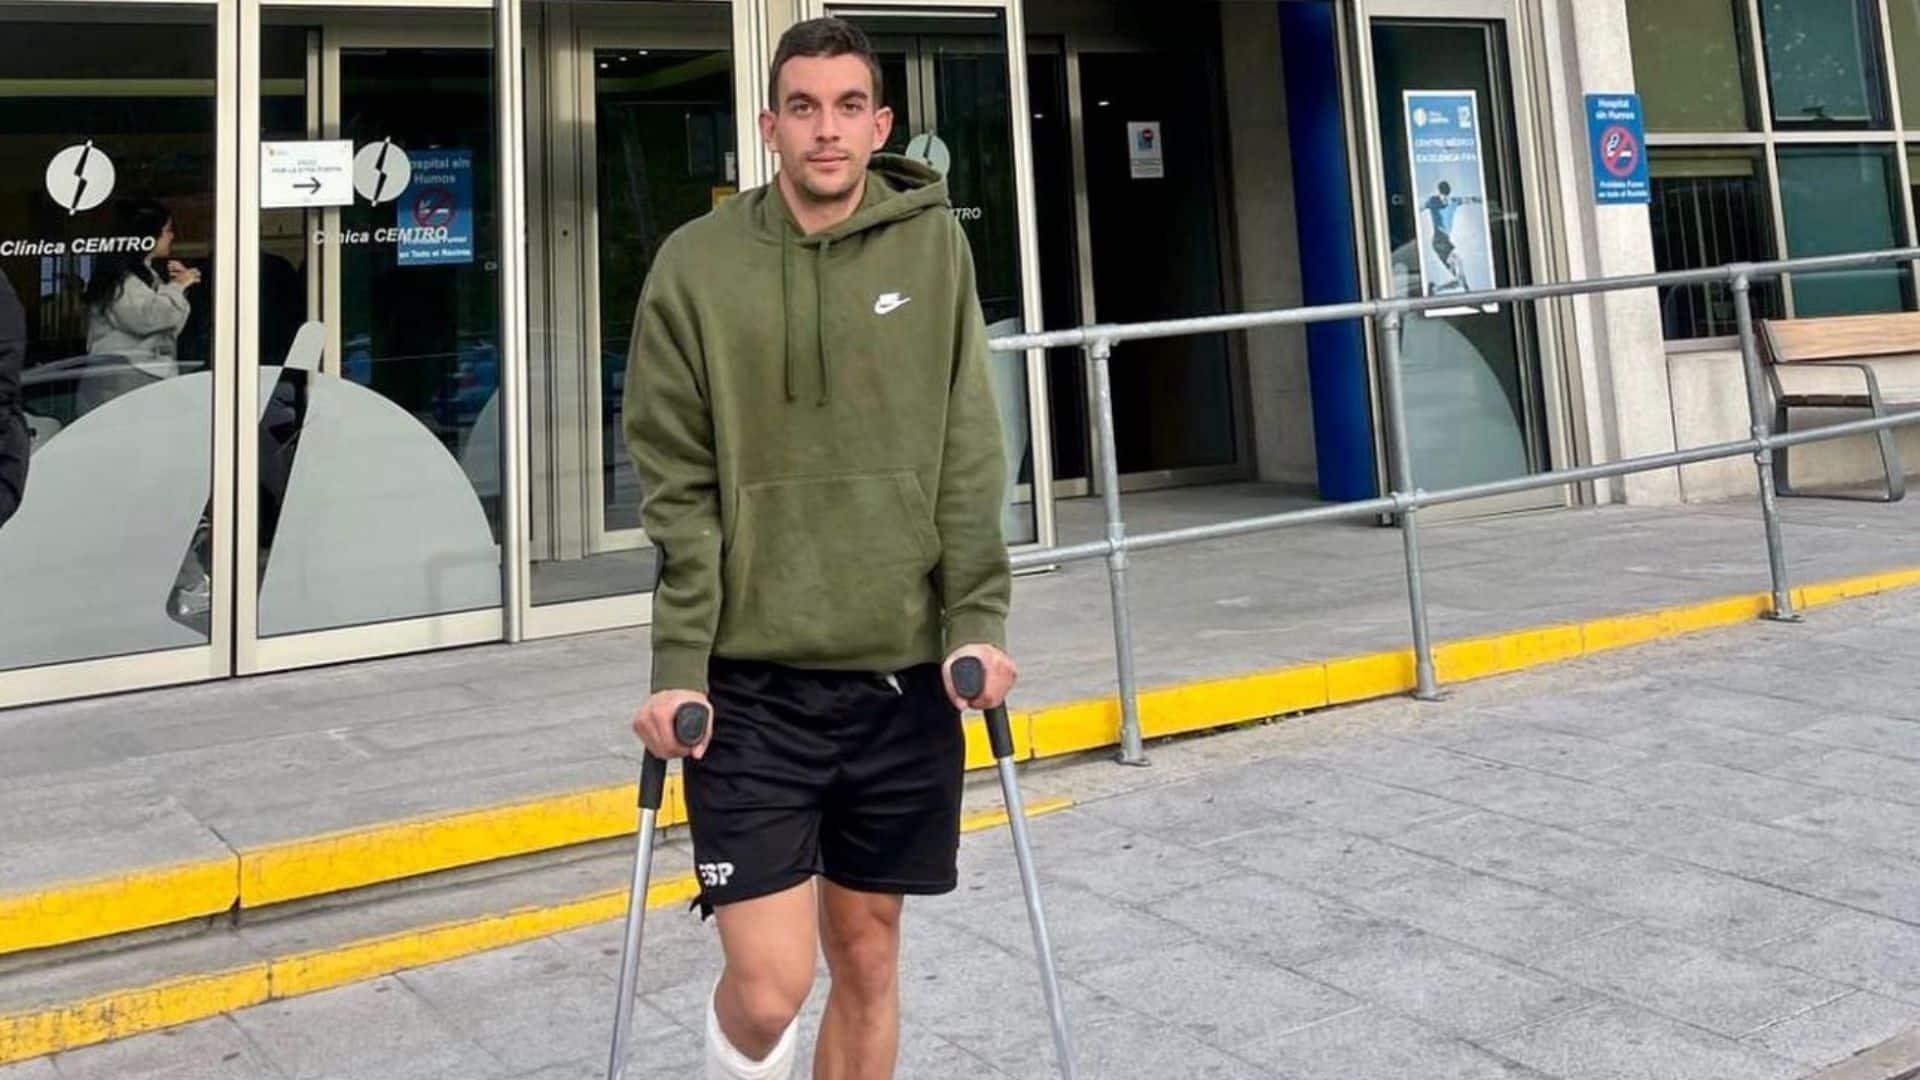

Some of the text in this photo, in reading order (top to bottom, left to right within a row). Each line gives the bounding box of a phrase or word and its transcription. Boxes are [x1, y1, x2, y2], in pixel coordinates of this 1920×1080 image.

[410, 157, 449, 170] ospital
[950, 207, 982, 220] TRO
[374, 226, 448, 243] CEMTRO
[0, 236, 156, 256] Clínica CEMTRO
